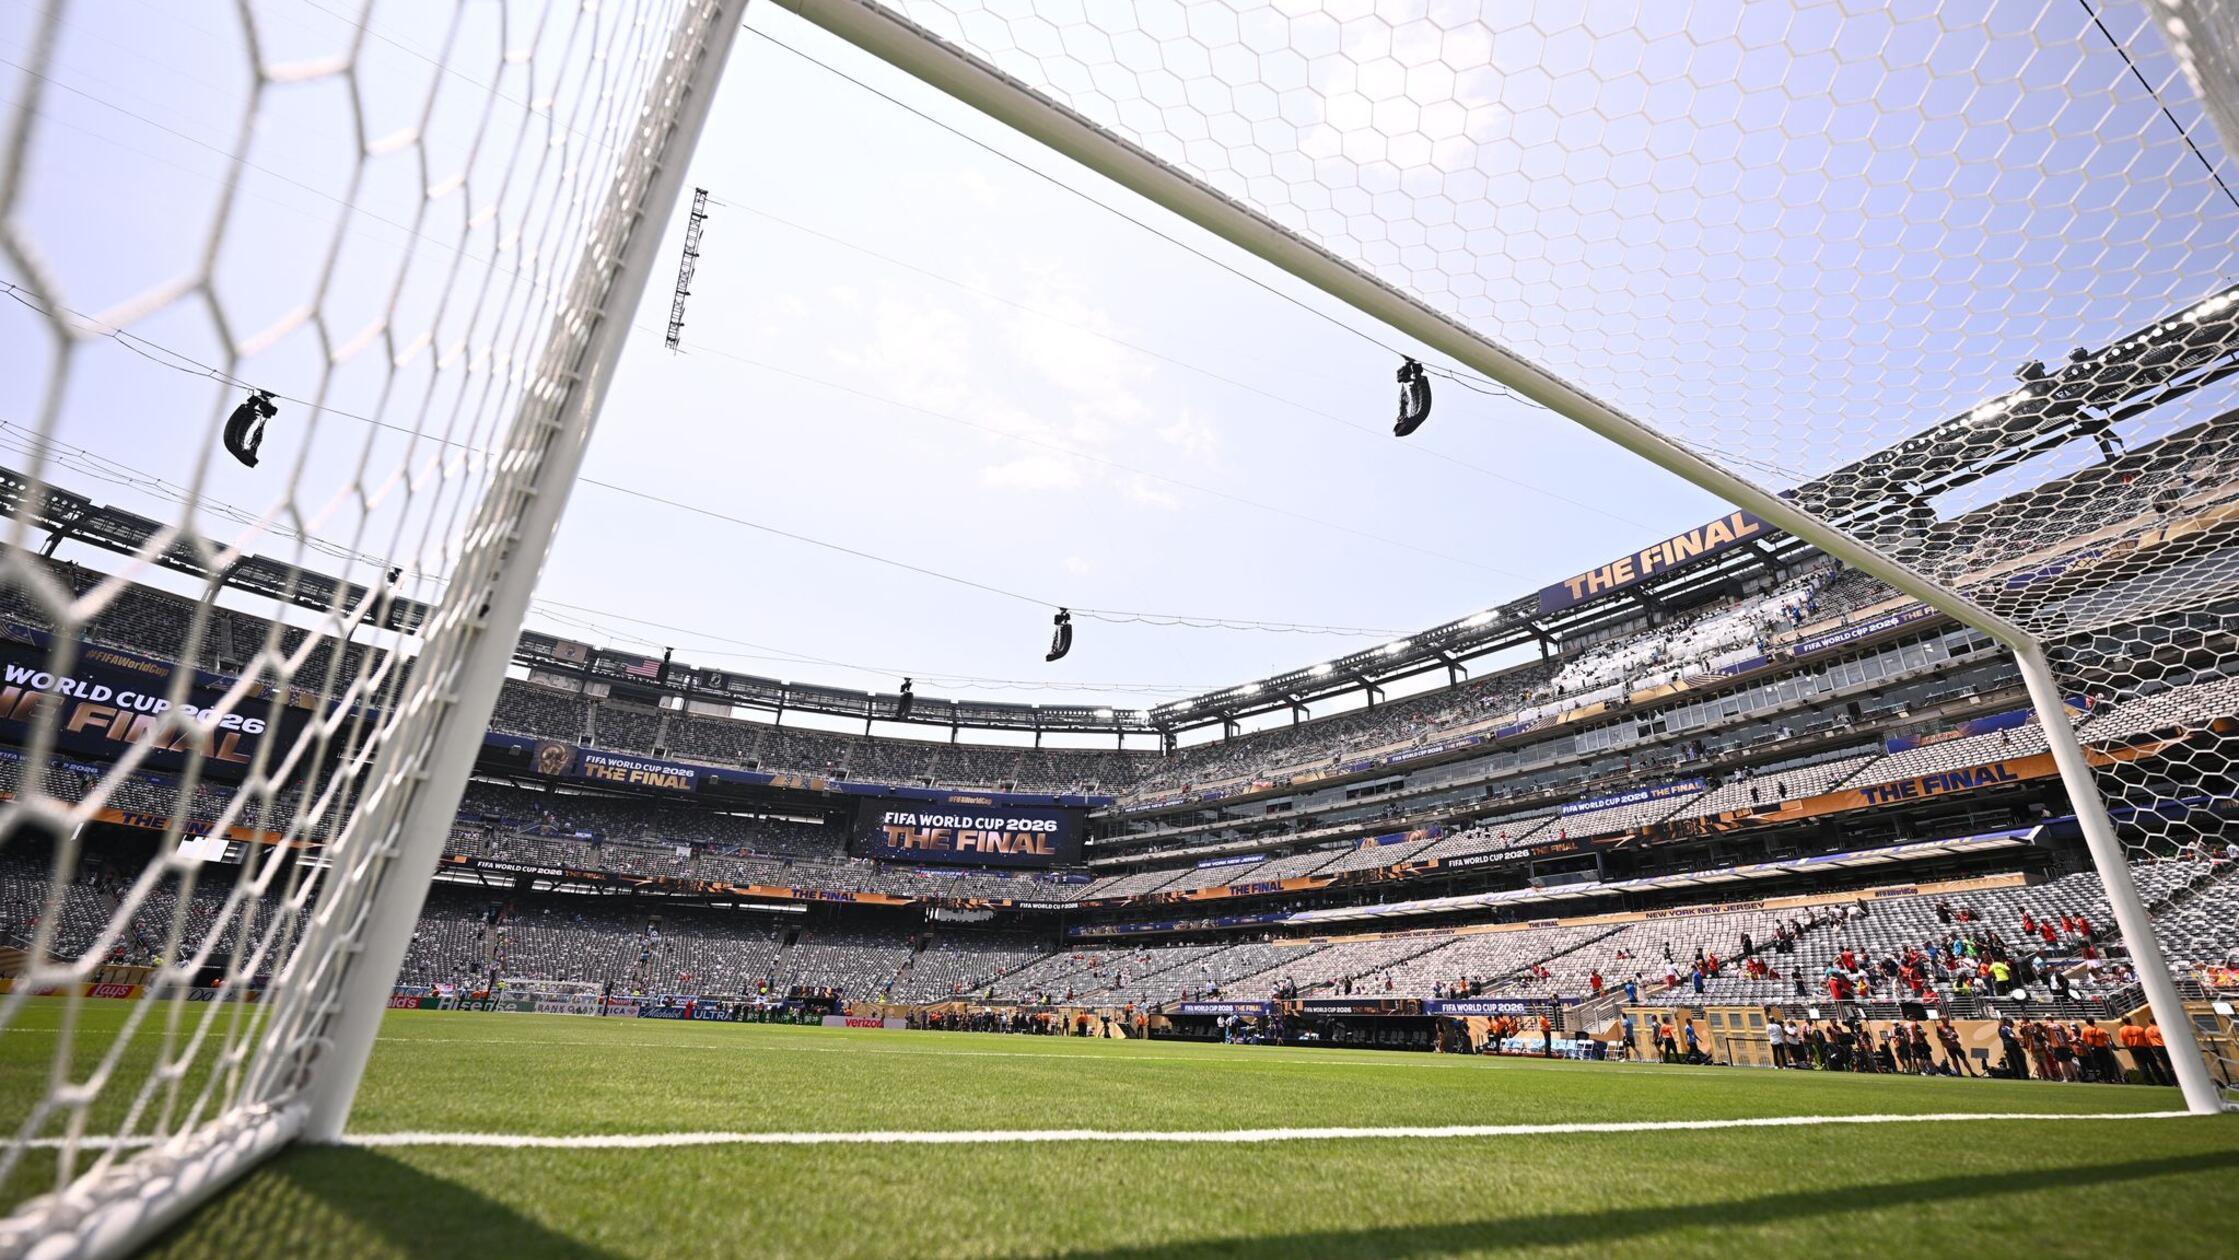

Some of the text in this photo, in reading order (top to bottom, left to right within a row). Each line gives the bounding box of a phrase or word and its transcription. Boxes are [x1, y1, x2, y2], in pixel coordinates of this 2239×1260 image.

[1564, 512, 1760, 600] THE FINAL
[1804, 642, 1821, 652] FIFA
[1821, 632, 1851, 647] WORLD
[1852, 627, 1868, 637] CUP
[1869, 618, 1899, 632] 2026
[4, 664, 113, 702] WORLD
[116, 691, 173, 717] CUP
[585, 755, 694, 778] FIFA WORLD CUP 2026
[584, 763, 691, 791] THE FINAL
[1860, 764, 2018, 805] THE FINAL
[1563, 781, 1701, 814] FIFA WORLD CUP 2026 THE FINAL
[122, 812, 167, 828] THE
[884, 812, 1058, 832] FIFA WORLD CUP 2026
[883, 825, 1056, 855] THE FINAL
[495, 863, 521, 871] WORLD
[1449, 859, 1463, 867] FIFA
[1464, 855, 1489, 865] WORLD
[1489, 853, 1504, 862] CUP
[1504, 849, 1530, 860] 2026
[791, 888, 857, 901] THE FINAL
[1229, 881, 1285, 895] THE FINAL
[1645, 902, 1765, 919] NEW YORK NEW JERSEY
[1540, 920, 1559, 928] FINAL
[538, 1003, 565, 1013] BANK
[694, 1008, 733, 1021] ULTRA
[1442, 1004, 1456, 1012] FIFA
[1457, 1004, 1482, 1012] WORLD
[1482, 1004, 1497, 1012] CUP
[1497, 1003, 1525, 1012] 2026
